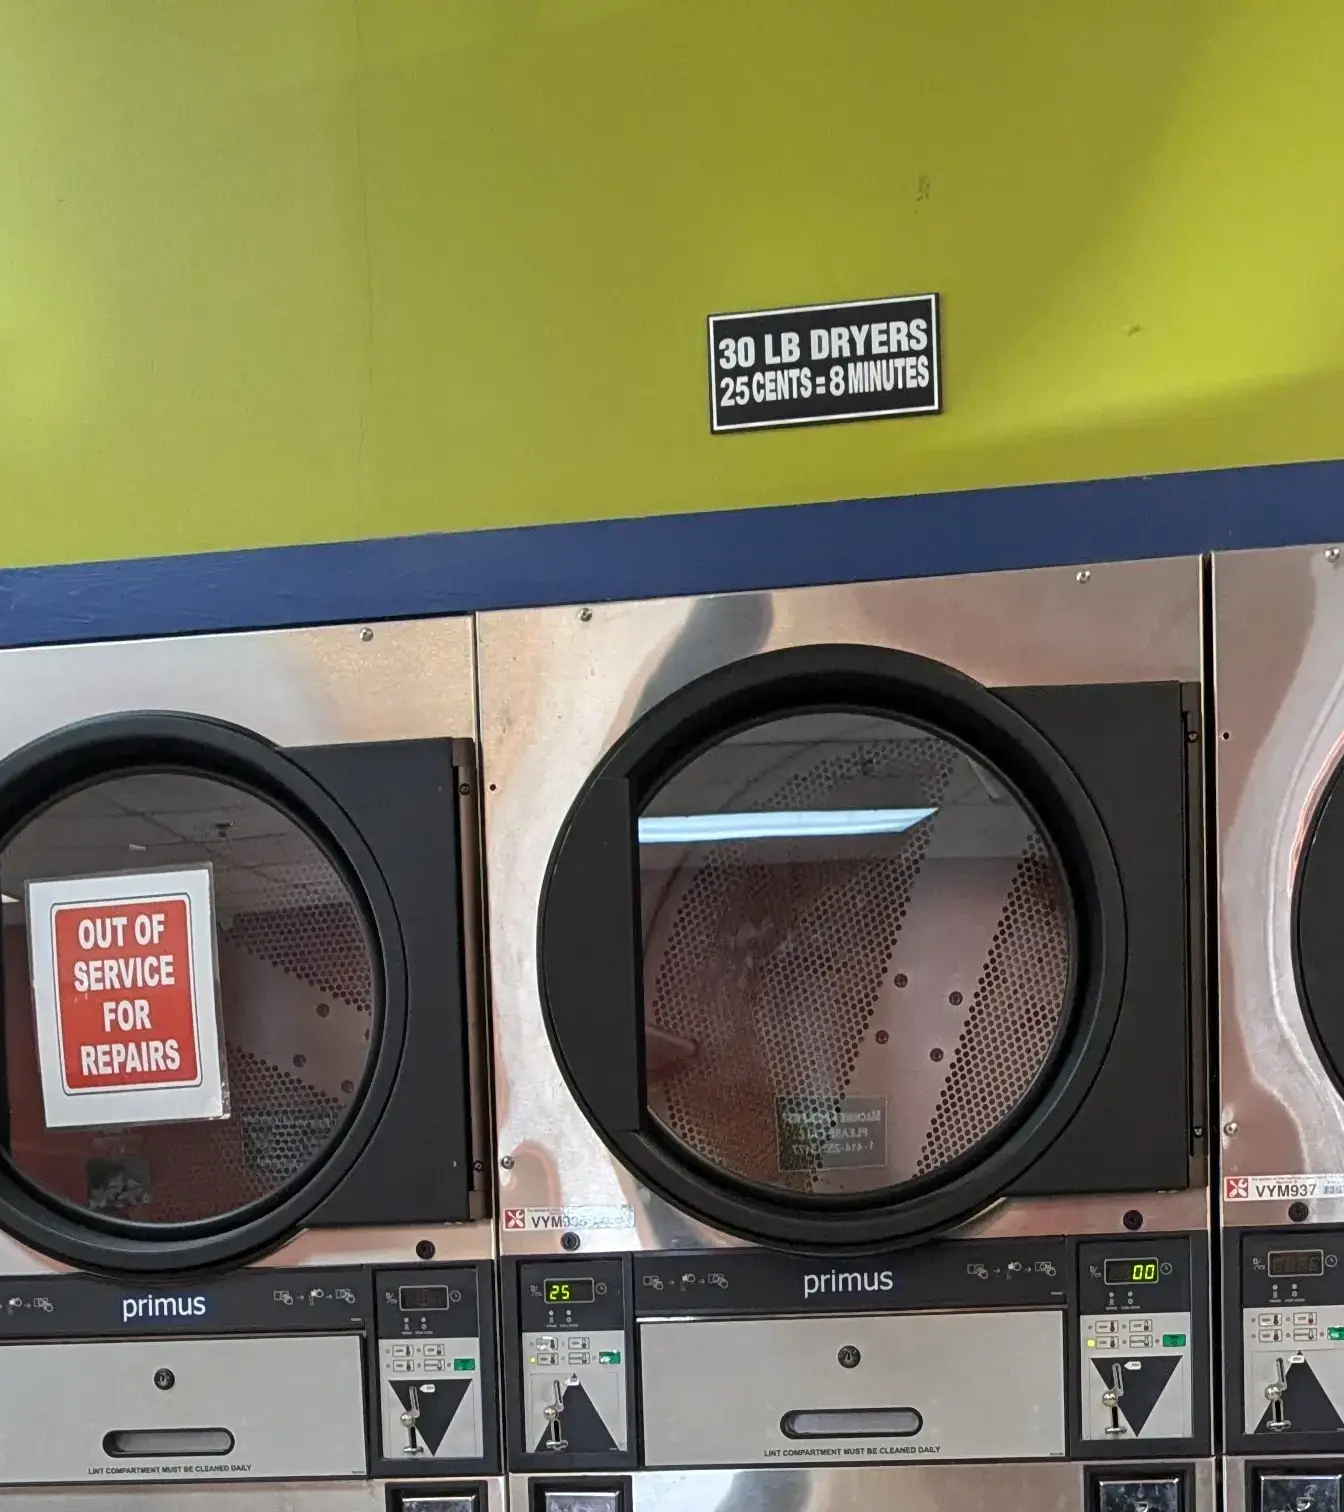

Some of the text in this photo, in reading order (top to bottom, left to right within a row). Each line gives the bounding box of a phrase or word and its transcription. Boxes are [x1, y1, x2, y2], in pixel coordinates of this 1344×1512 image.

[719, 318, 928, 369] 30 LB DRYERS
[721, 355, 929, 407] 25 CENTS = 8 MINUTES
[78, 914, 164, 949] OUT OF
[74, 955, 175, 992] SERVICE
[103, 999, 152, 1032] FOR
[81, 1039, 180, 1075] REPAIRS
[1256, 1184, 1316, 1197] VYM937
[802, 1268, 894, 1298] primus
[1132, 1264, 1155, 1280] 00
[122, 1293, 206, 1322] primus
[550, 1285, 570, 1300] 25
